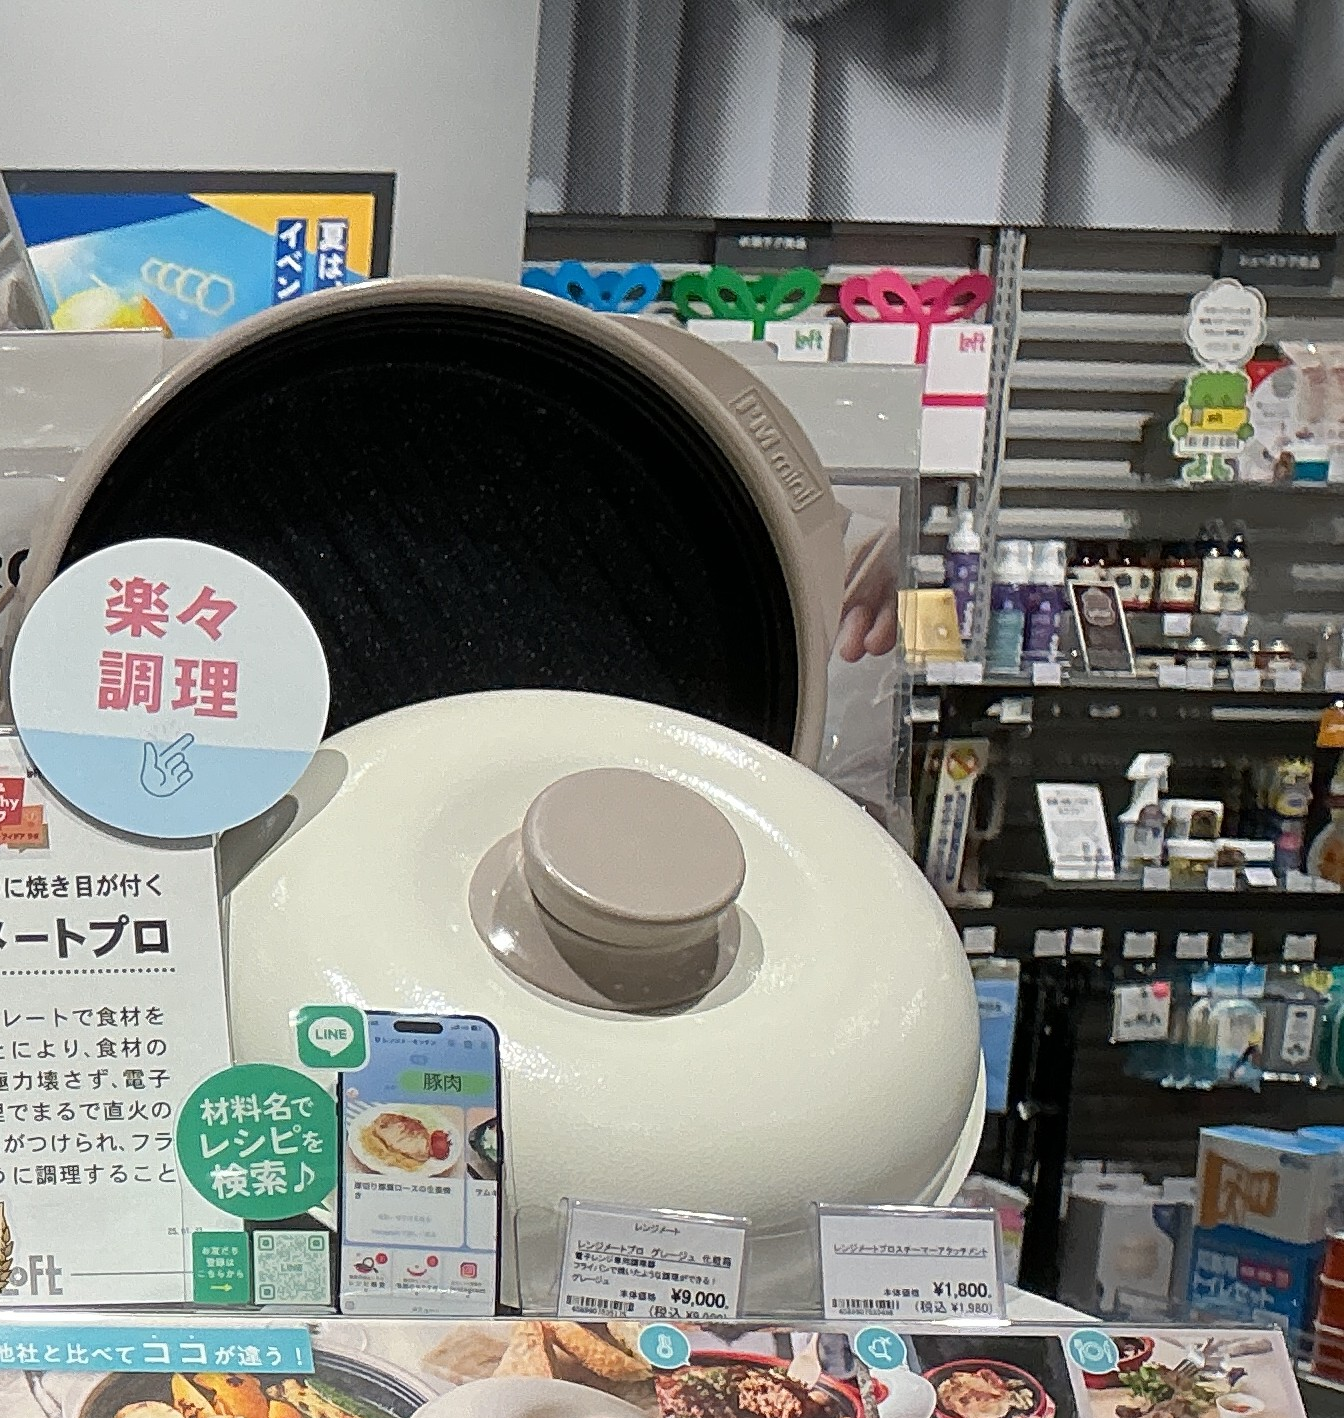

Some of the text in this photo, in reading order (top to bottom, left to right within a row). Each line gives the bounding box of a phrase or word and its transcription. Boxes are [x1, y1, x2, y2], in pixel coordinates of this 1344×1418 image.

[105, 577, 238, 642] 楽々
[98, 650, 239, 720] 調理
[315, 1028, 348, 1041] LINE
[423, 1072, 462, 1093] 豚肉
[200, 1093, 314, 1126] 材料名で
[200, 1124, 323, 1159] レシピを
